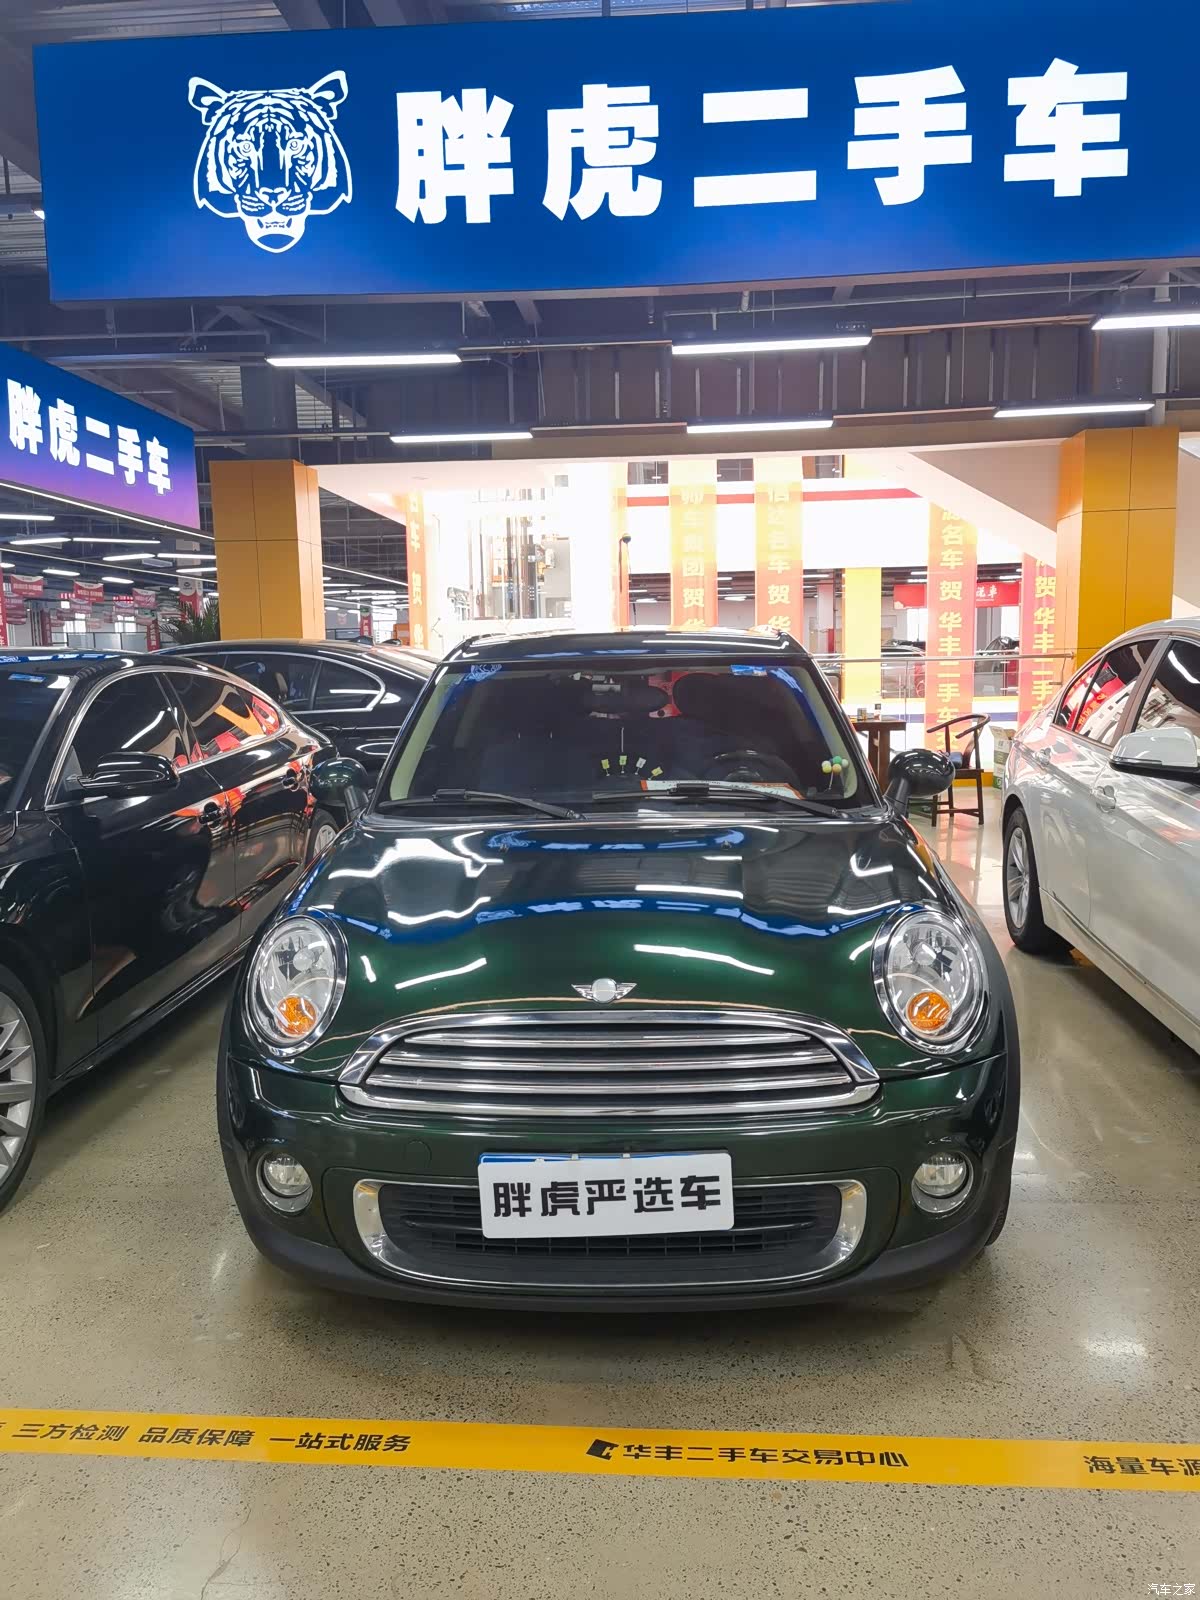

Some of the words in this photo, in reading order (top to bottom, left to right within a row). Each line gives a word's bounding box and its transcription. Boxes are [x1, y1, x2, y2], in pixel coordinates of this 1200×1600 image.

[396, 59, 1129, 224] 胖虎二手车
[6, 378, 173, 495] 胖虎二手车
[1031, 557, 1056, 713] 贺华丰二手
[493, 1175, 721, 1218] 胖虎严选车
[12, 1423, 130, 1442] 三方检测
[138, 1427, 256, 1447] 品质保障
[269, 1431, 411, 1452] 一站式服务
[622, 1442, 909, 1467] 华丰二手车交易中心
[1083, 1455, 1200, 1477] 海量车源
